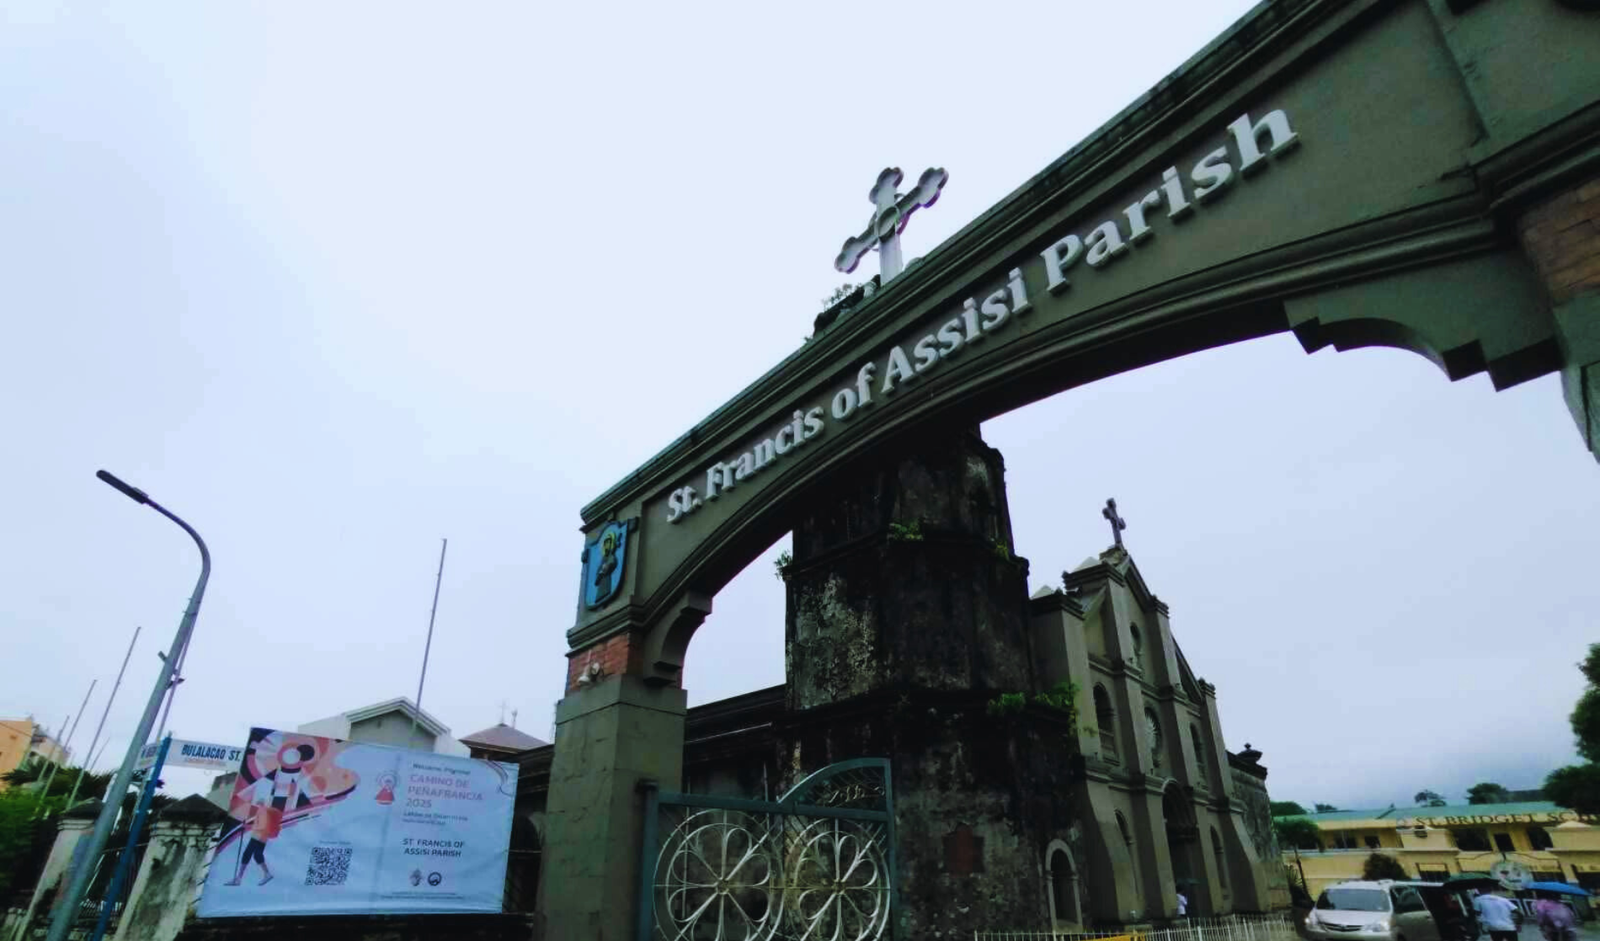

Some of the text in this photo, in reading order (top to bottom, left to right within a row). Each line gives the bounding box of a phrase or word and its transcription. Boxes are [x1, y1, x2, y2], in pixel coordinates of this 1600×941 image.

[667, 108, 1299, 523] St. Francis of Assisi Parish
[181, 744, 242, 761] BULALACAO ST.
[410, 774, 471, 789] CAMINO DE
[405, 799, 432, 808] 2025
[1445, 813, 1535, 826] BRIDGET
[417, 839, 452, 848] FRANCIS
[454, 840, 465, 849] OF
[403, 847, 462, 858] ASSISI PARISH
